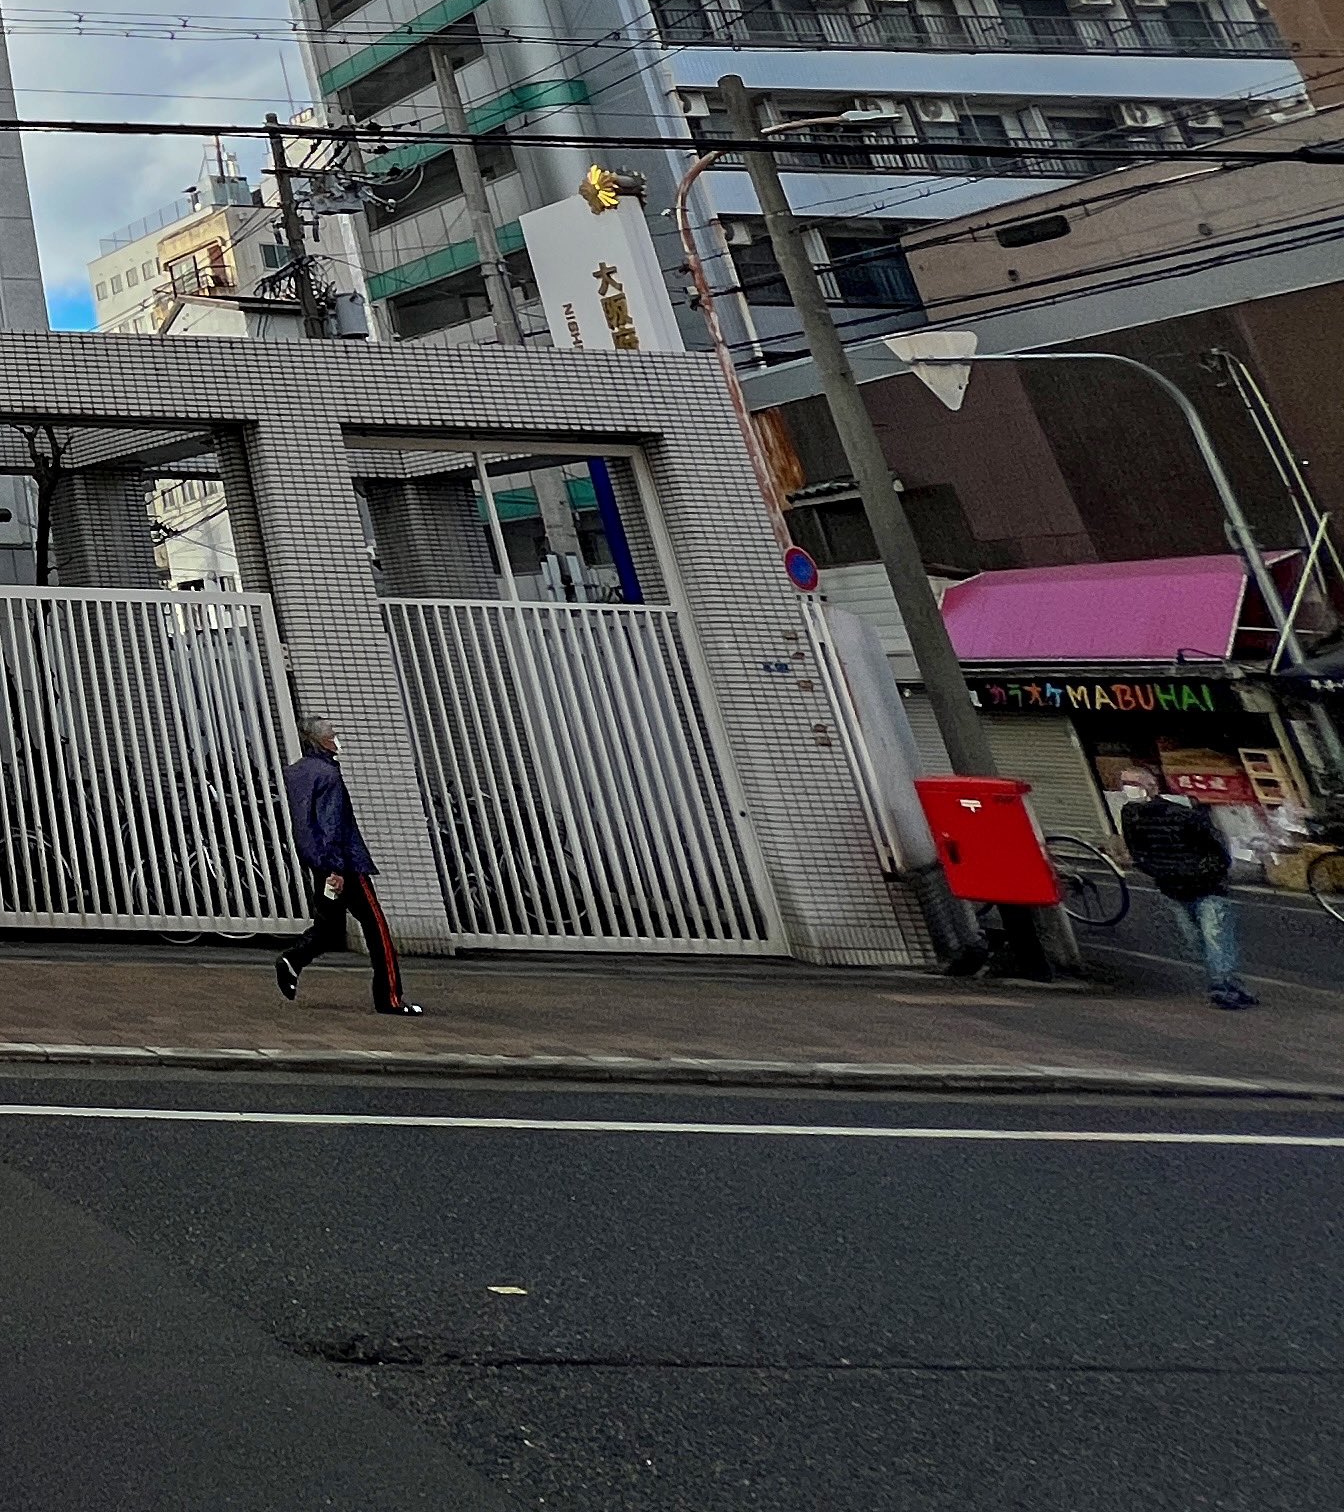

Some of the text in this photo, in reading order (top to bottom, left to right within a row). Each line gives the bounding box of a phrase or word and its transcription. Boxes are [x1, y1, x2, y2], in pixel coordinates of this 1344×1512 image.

[986, 683, 1062, 708] カラオケ
[1066, 684, 1215, 711] MABUHAI
